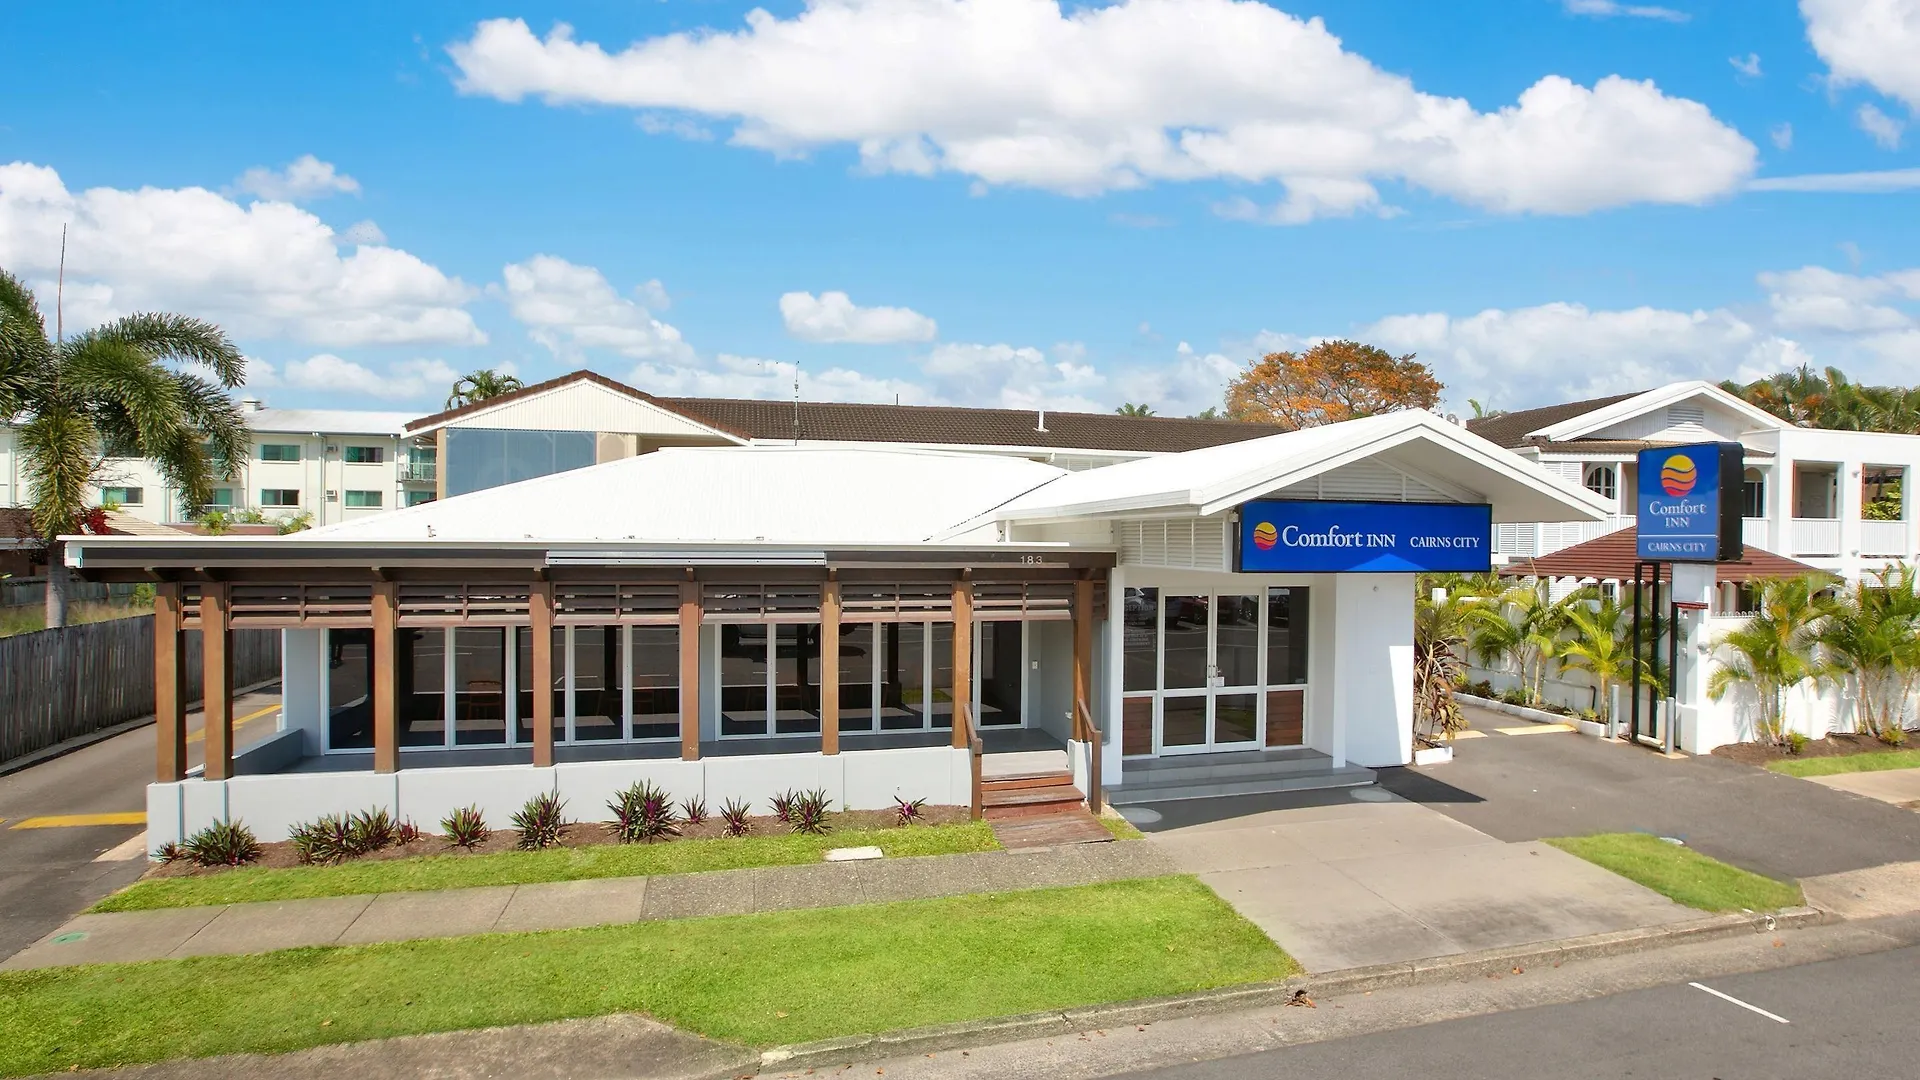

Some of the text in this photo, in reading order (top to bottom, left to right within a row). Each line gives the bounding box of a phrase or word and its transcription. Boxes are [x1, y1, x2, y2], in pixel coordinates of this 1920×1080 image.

[1650, 499, 1707, 515] Comfort
[1665, 517, 1691, 528] INN
[1282, 525, 1480, 548] Comfort INN CAIRNS CITY
[1647, 542, 1707, 552] CAIRNS CITY
[1020, 555, 1043, 565] 183
